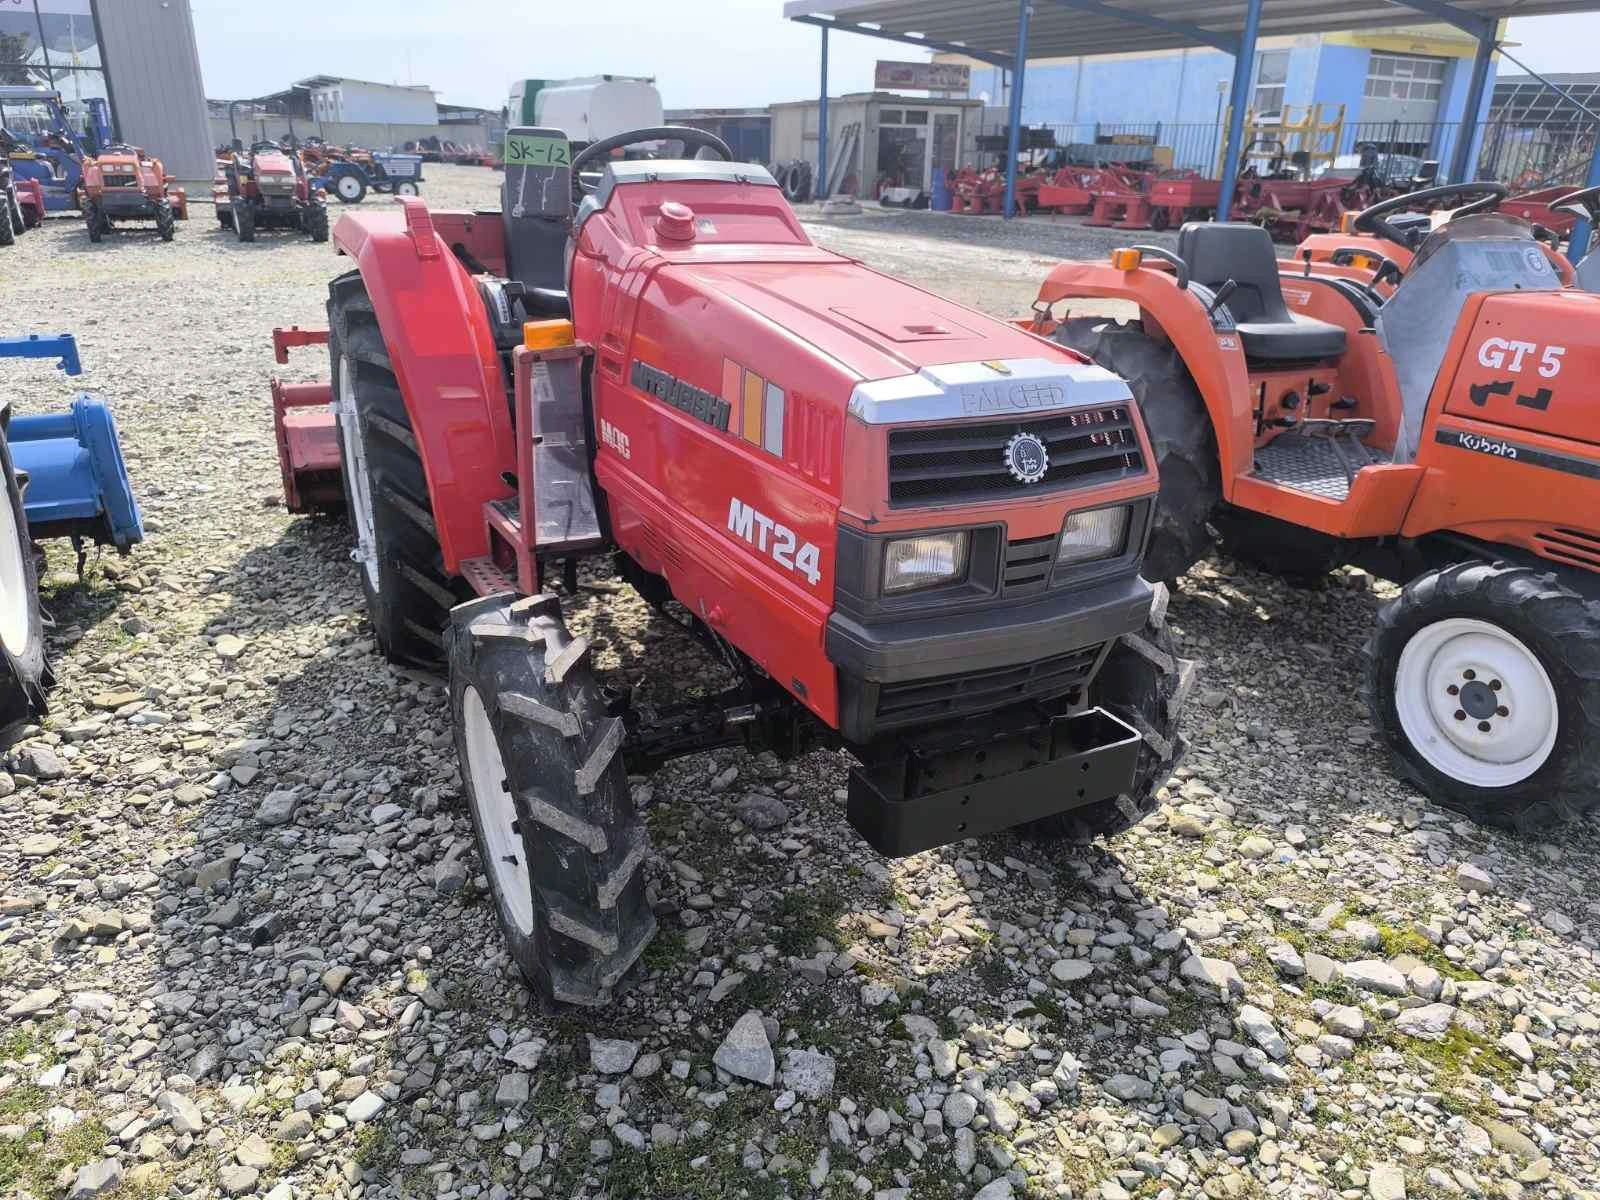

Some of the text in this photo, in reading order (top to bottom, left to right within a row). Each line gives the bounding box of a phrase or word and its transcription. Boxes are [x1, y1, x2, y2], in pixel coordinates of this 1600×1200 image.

[1478, 337, 1565, 377] GT 5
[1459, 432, 1517, 458] Kubota
[728, 496, 821, 586] MT24
